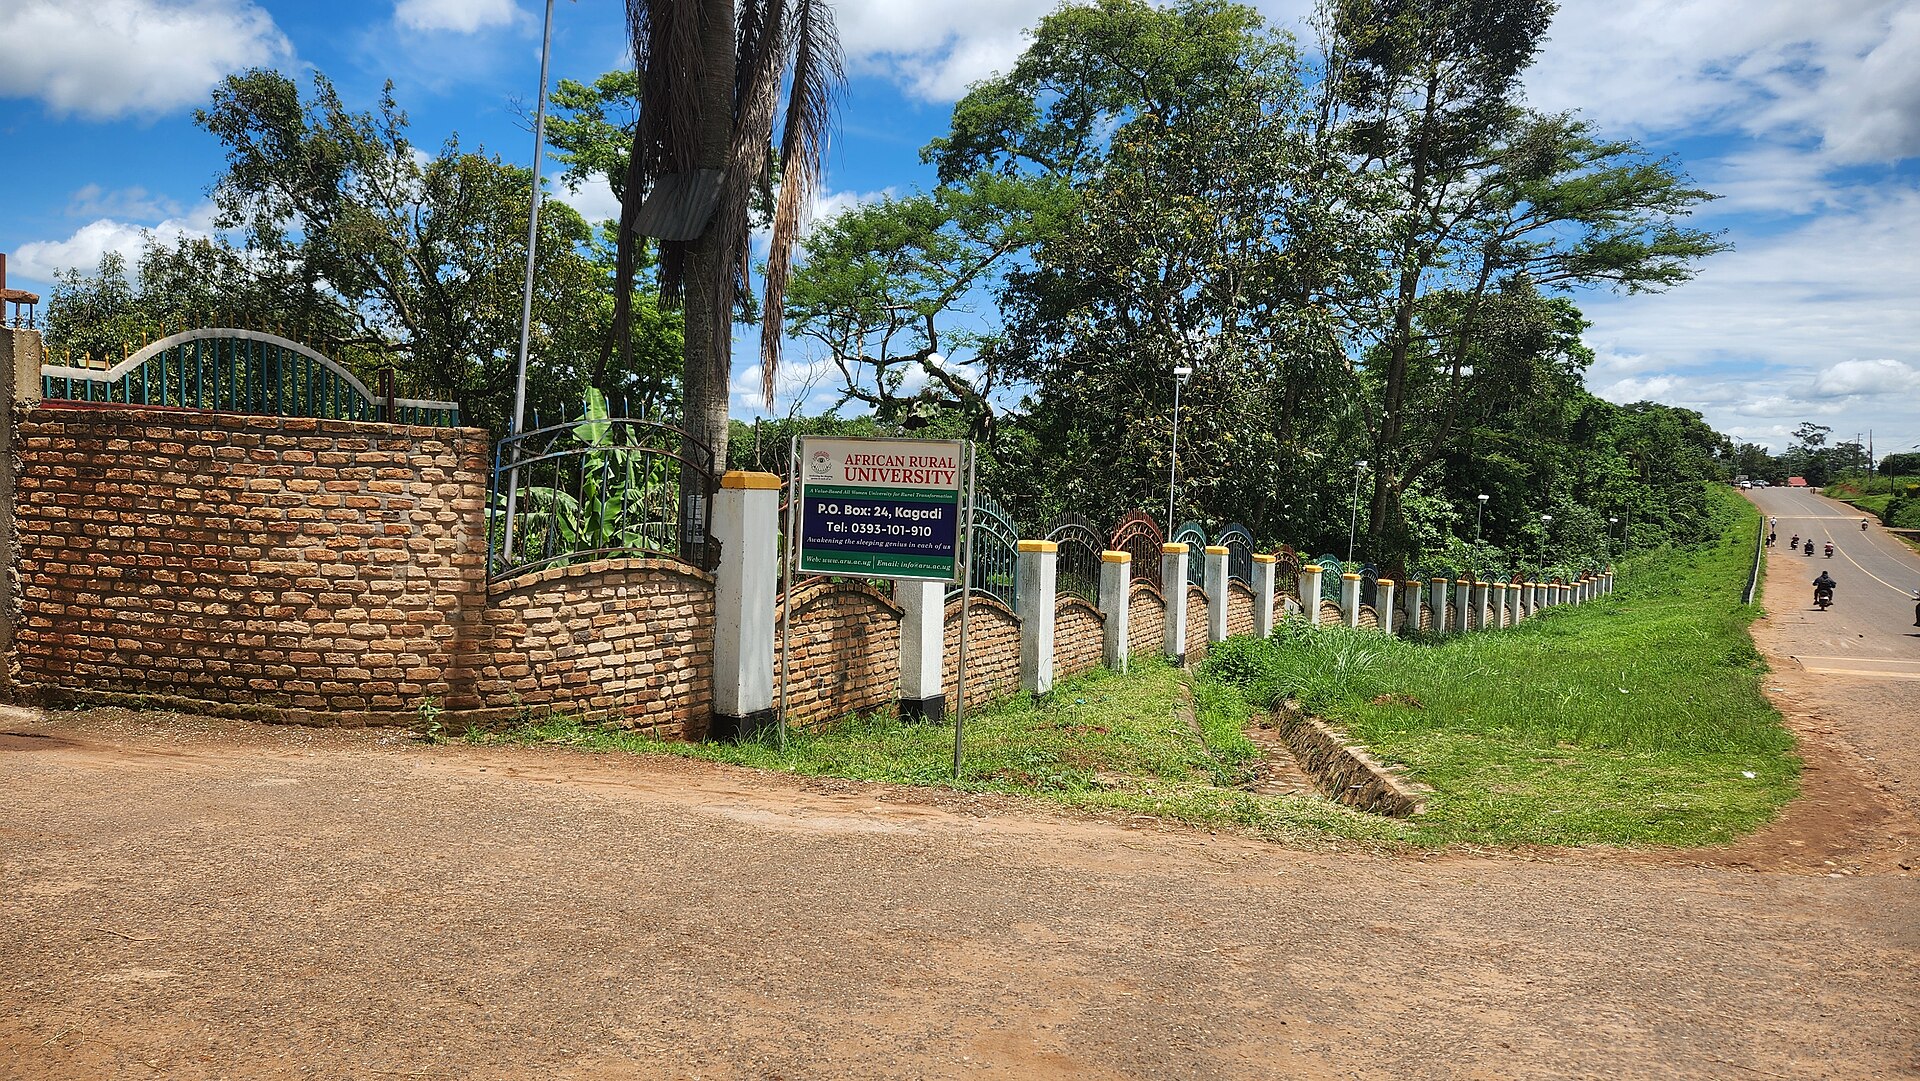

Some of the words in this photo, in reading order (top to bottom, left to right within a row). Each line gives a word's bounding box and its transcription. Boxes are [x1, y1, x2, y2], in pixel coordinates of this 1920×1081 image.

[845, 454, 905, 467] AFRICAN
[909, 456, 956, 468] RURAL
[844, 467, 955, 484] UNIVERSITY
[818, 503, 841, 515] P.O.
[844, 505, 871, 516] Box:
[873, 506, 892, 519] 24,
[895, 507, 942, 520] Kagadi
[826, 522, 848, 533] Tel:
[851, 523, 932, 537] 0393-101-910
[806, 537, 843, 545] Awakening
[856, 539, 884, 547] sleeping
[876, 559, 900, 568] Email:
